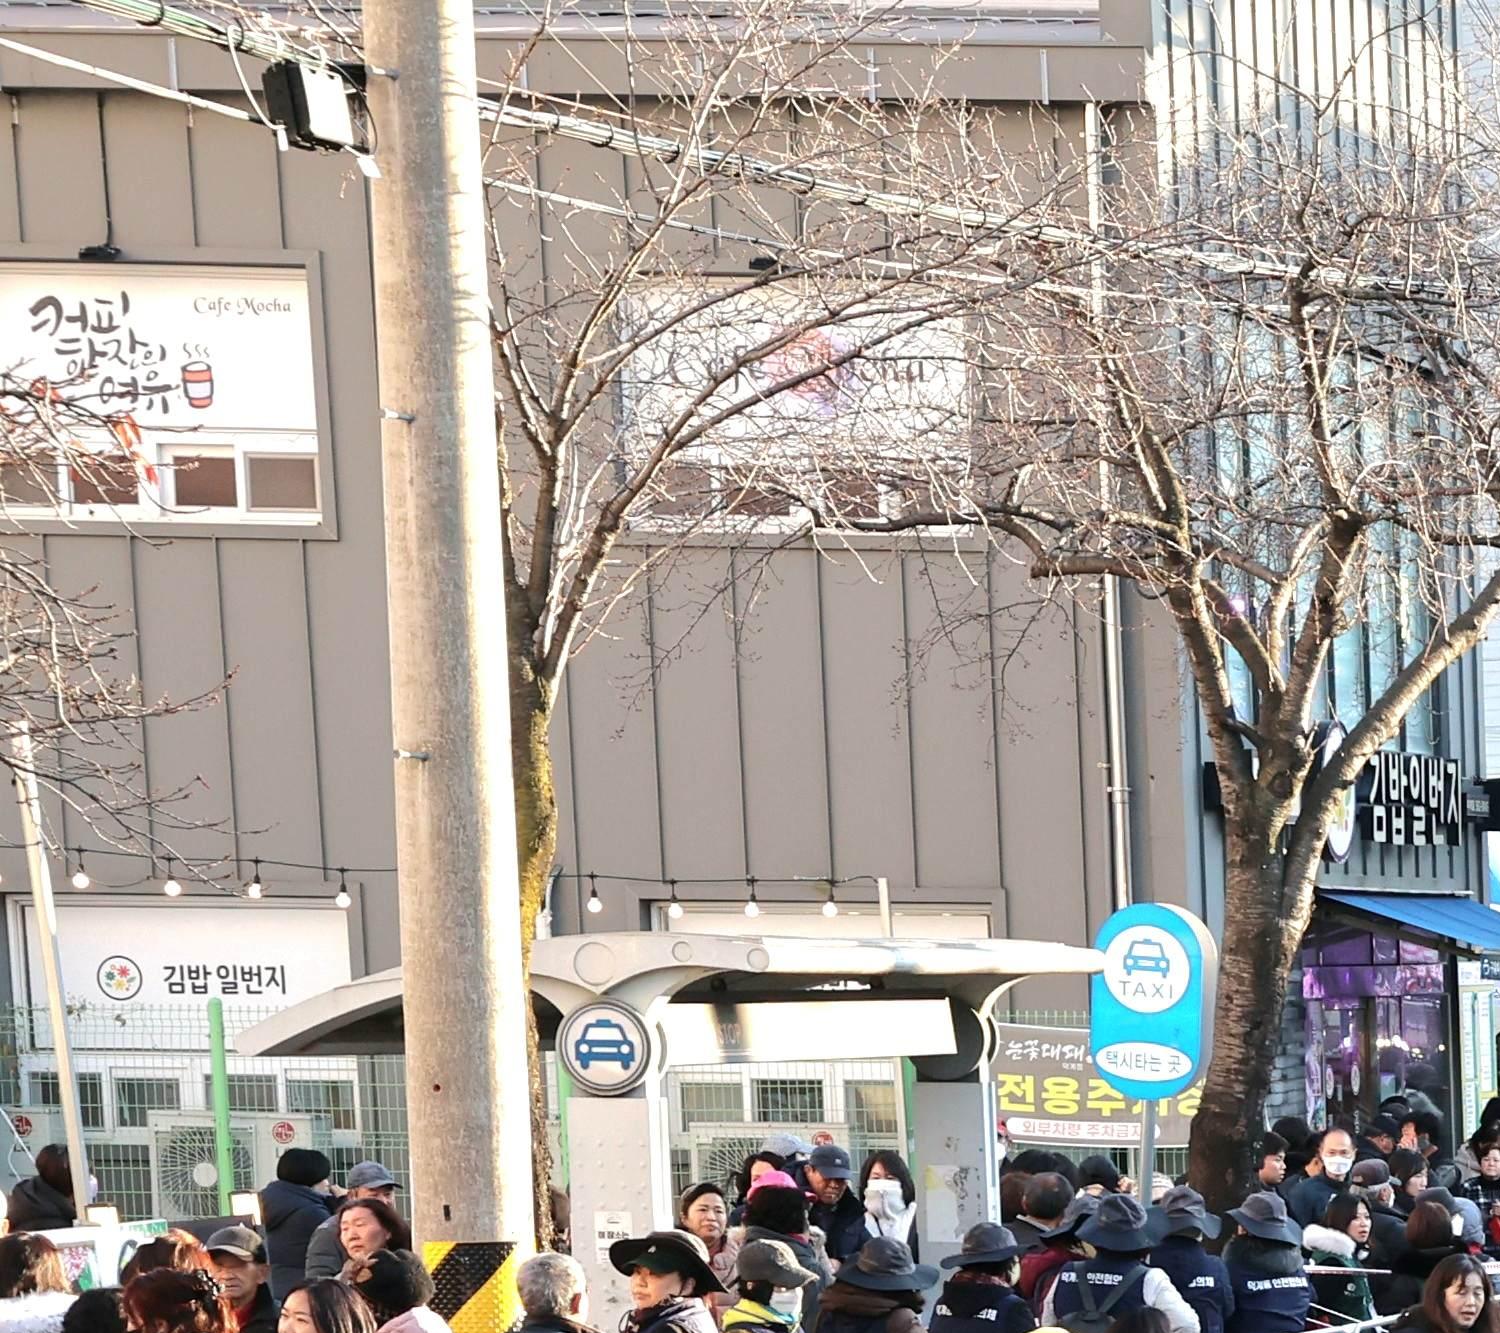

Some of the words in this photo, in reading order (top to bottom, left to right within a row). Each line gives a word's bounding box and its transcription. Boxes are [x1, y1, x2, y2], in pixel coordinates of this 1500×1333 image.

[29, 291, 130, 336] 커피
[194, 297, 232, 317] Cafe
[236, 297, 292, 317] Mocha
[1117, 979, 1175, 1001] TAXI
[1105, 1050, 1161, 1072] 택시타는
[1167, 1055, 1182, 1074] 곳
